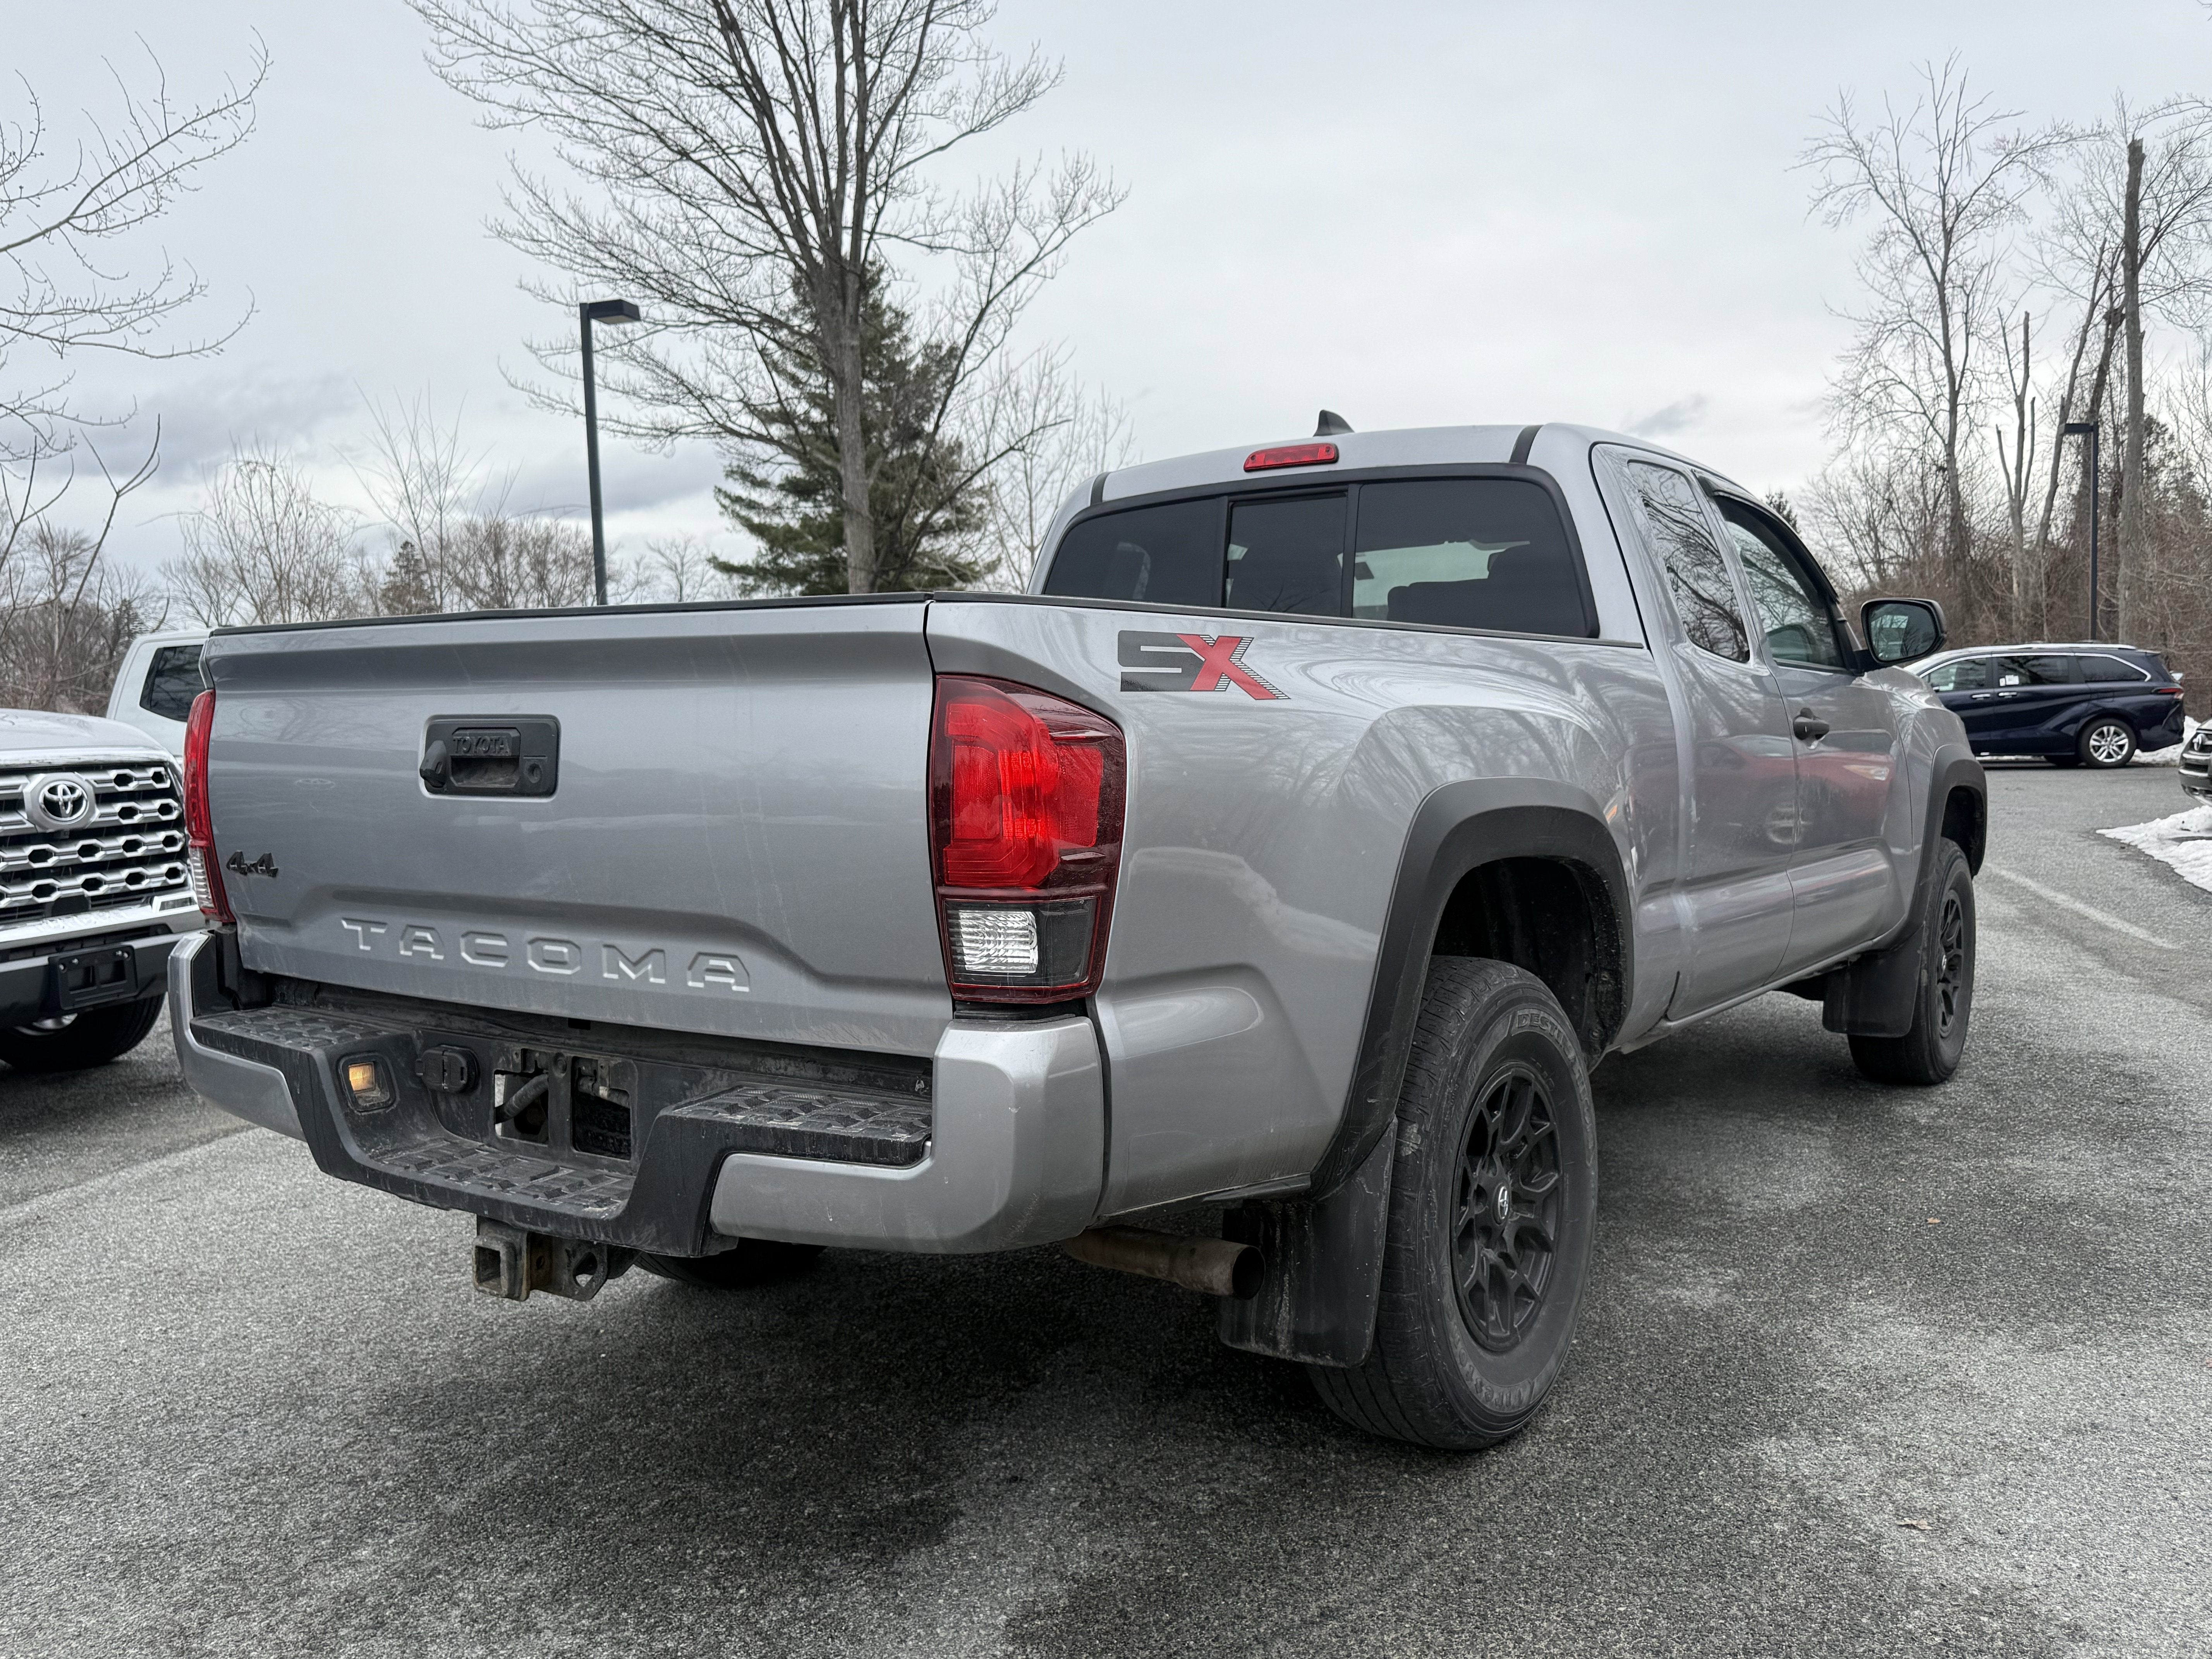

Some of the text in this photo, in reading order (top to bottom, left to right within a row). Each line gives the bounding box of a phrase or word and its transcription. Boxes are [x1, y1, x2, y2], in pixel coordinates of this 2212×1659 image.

[1118, 630, 1291, 700] SX
[452, 736, 510, 754] TOYOTA
[342, 917, 750, 992] TACOMA
